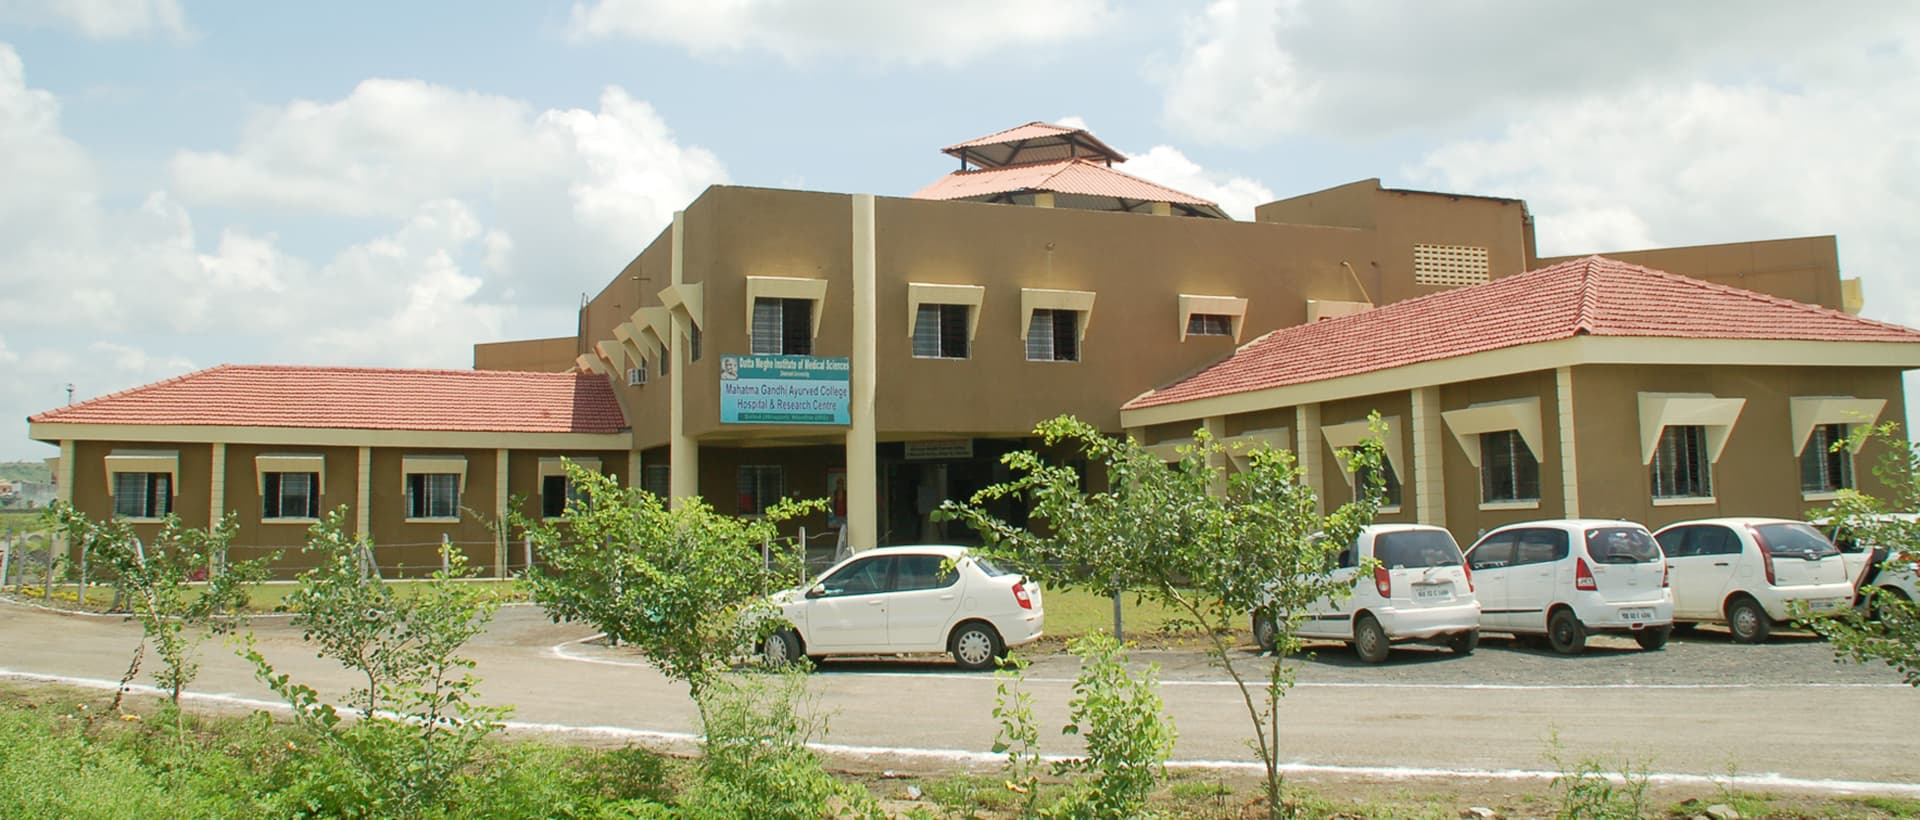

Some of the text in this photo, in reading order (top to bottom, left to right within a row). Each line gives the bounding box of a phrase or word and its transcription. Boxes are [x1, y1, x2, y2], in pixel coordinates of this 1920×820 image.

[755, 357, 774, 371] Meghe
[774, 358, 797, 369] Institute
[798, 358, 804, 369] of
[805, 359, 825, 370] Medical
[826, 359, 849, 371] Sciences
[726, 383, 847, 399] Mahatma Gandhi Ayurved College
[737, 399, 837, 410] Hospital & Research Centre
